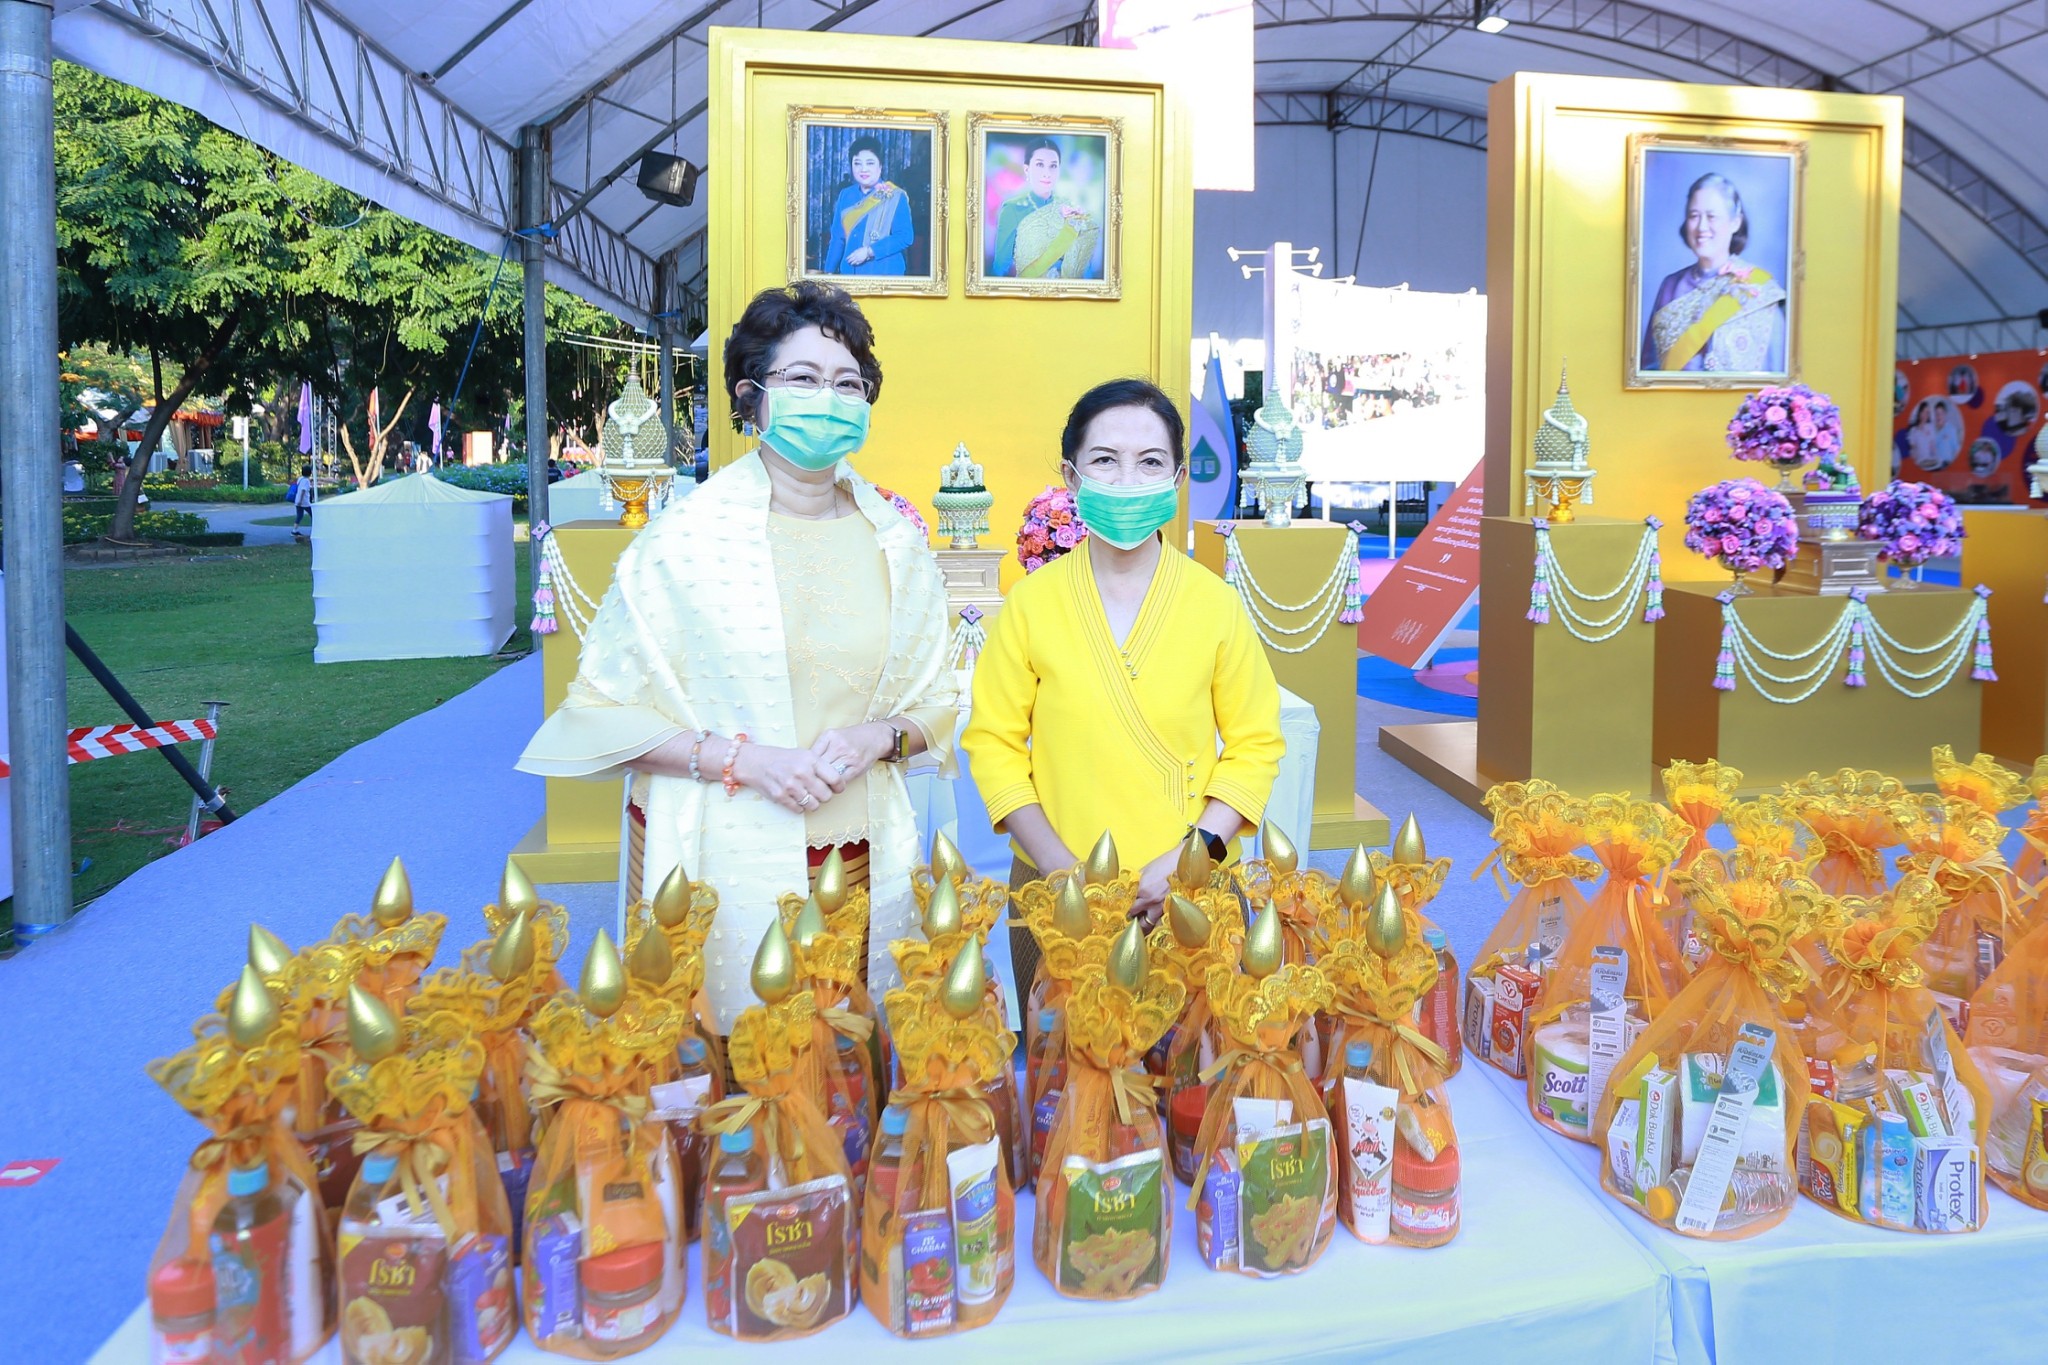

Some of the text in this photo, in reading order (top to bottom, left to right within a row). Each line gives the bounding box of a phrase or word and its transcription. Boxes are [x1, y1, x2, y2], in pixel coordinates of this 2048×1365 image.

[1469, 996, 1482, 1045] Protex
[1543, 1071, 1587, 1094] Scott
[1647, 1101, 1659, 1154] Dok Bua Ku
[1921, 1103, 1932, 1120] Dok
[1915, 1158, 1924, 1203] Protex
[1949, 1161, 1965, 1222] Protex
[766, 1217, 813, 1246] โรซ่า
